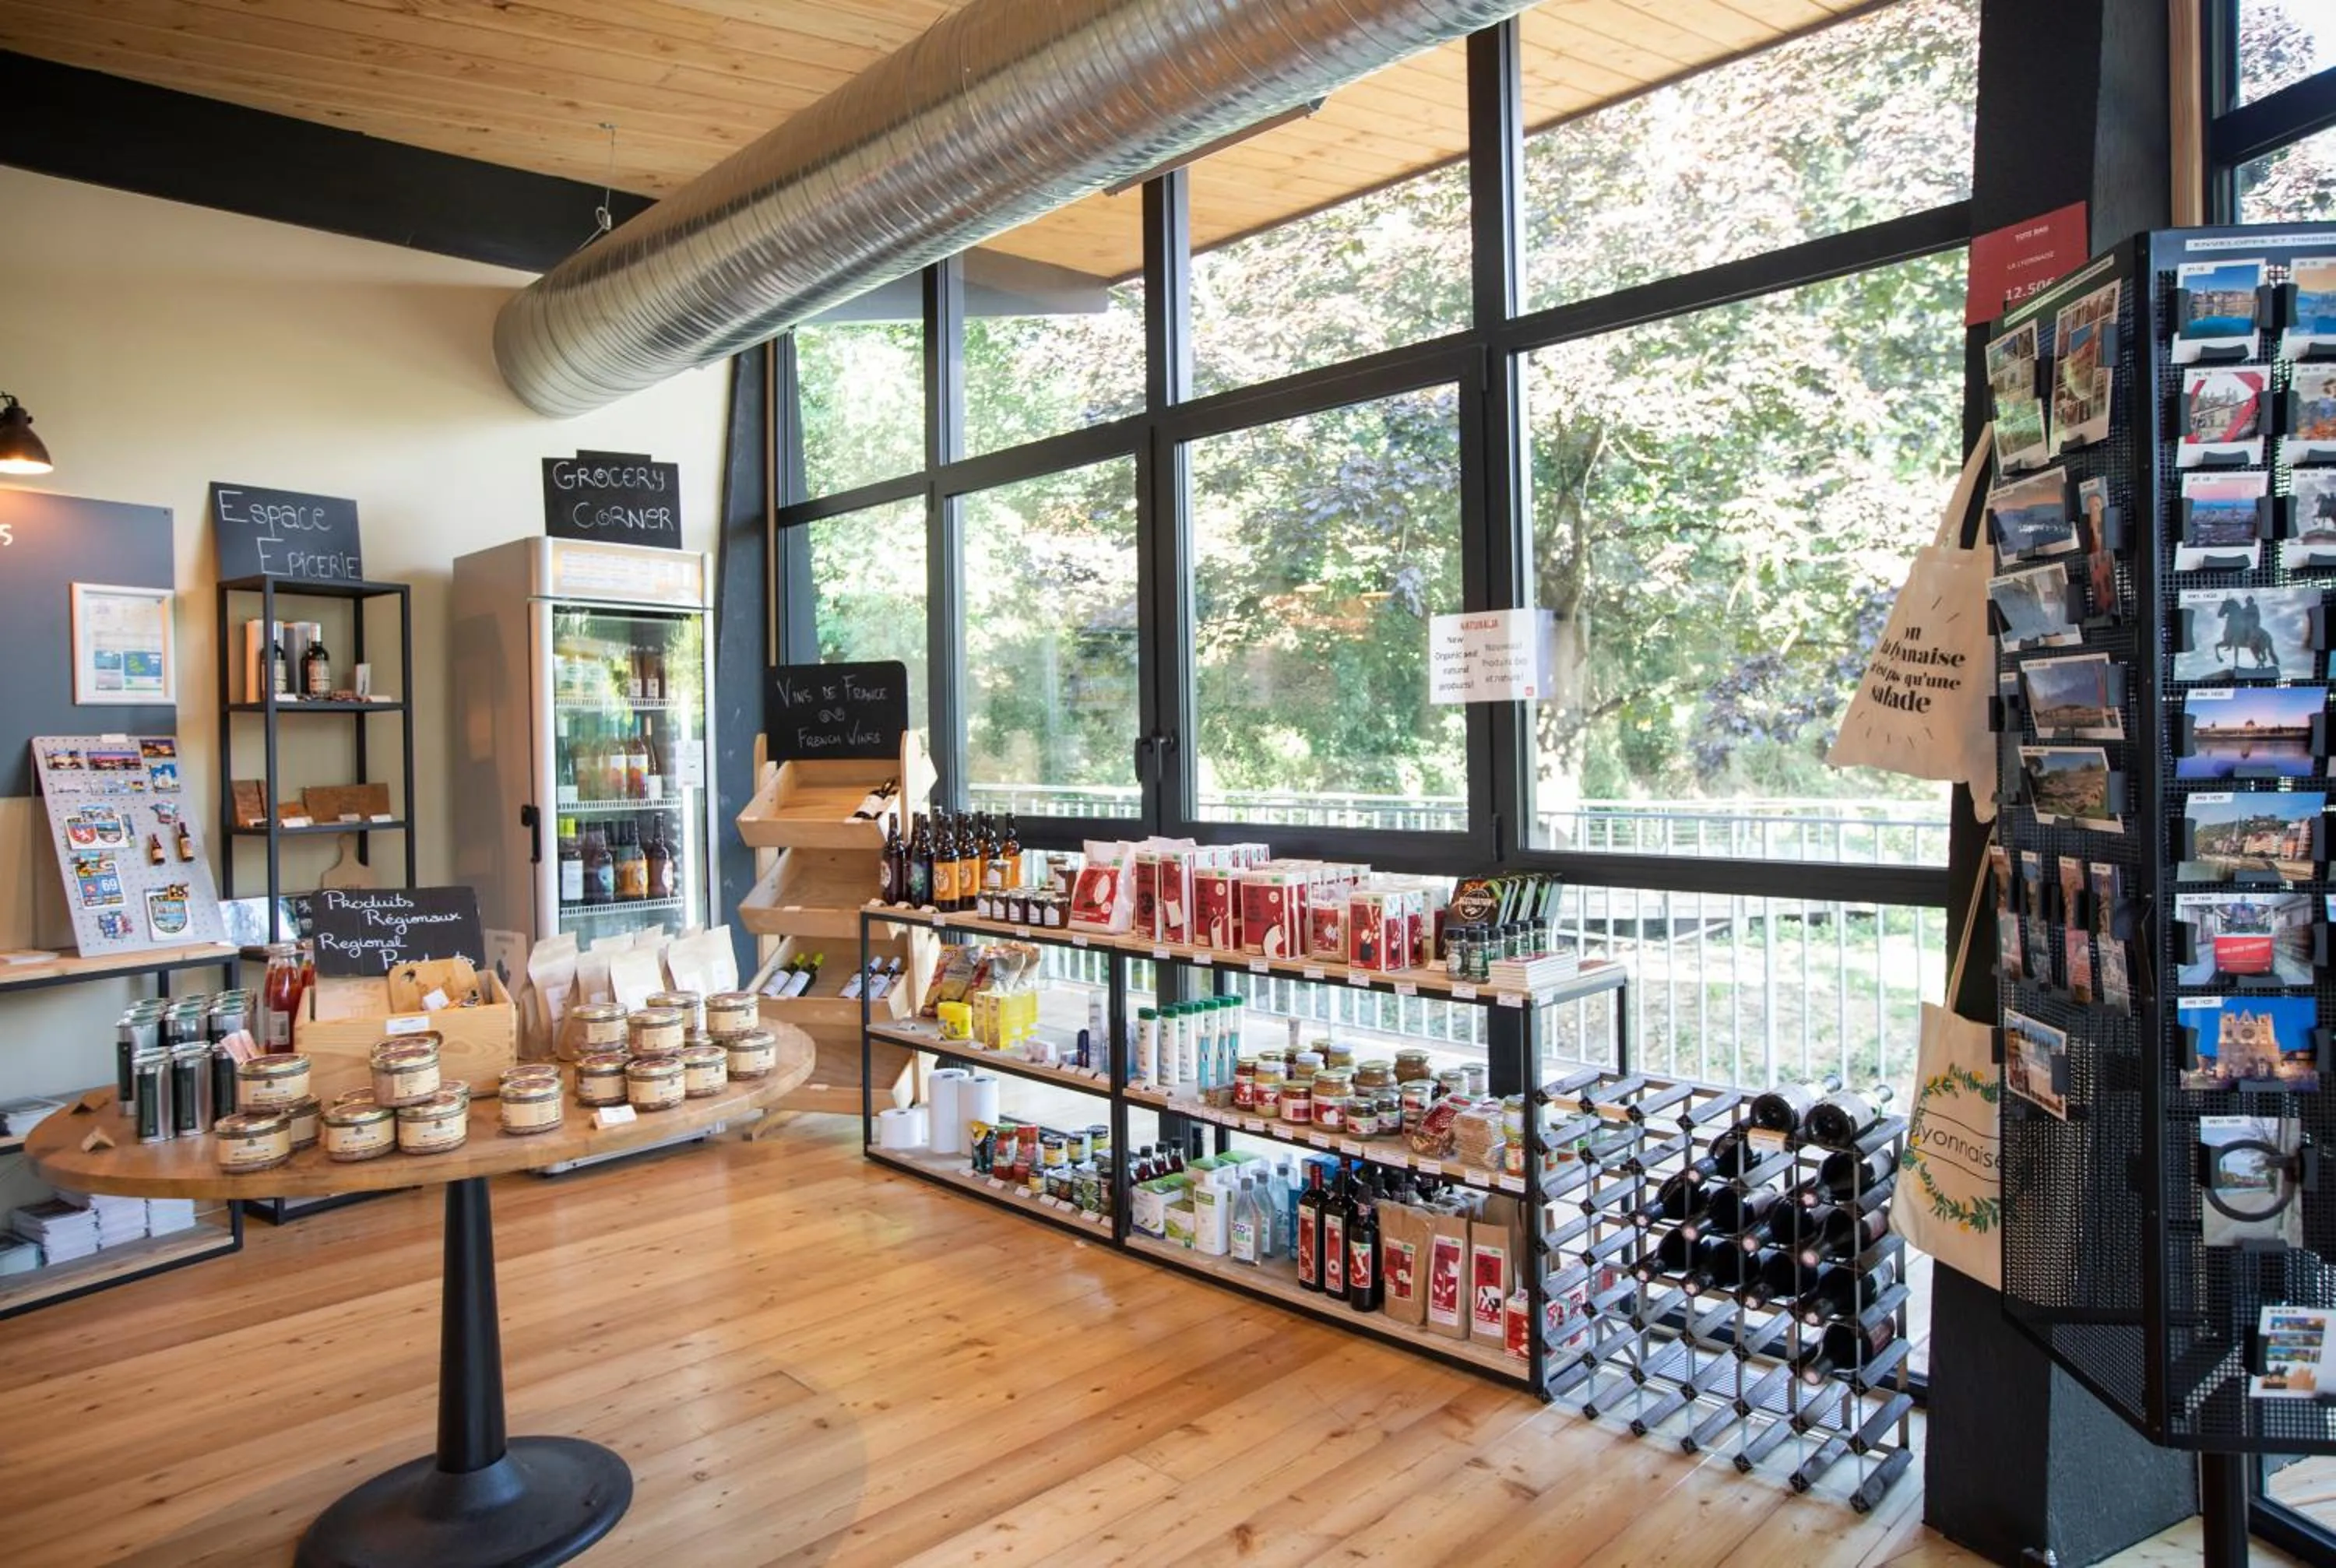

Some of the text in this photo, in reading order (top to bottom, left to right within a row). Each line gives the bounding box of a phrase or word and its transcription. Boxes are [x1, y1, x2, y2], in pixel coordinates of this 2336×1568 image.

[218, 489, 332, 538] Espace
[322, 890, 414, 910] Produits
[361, 909, 462, 934] Régionaux
[318, 933, 408, 958] Regional
